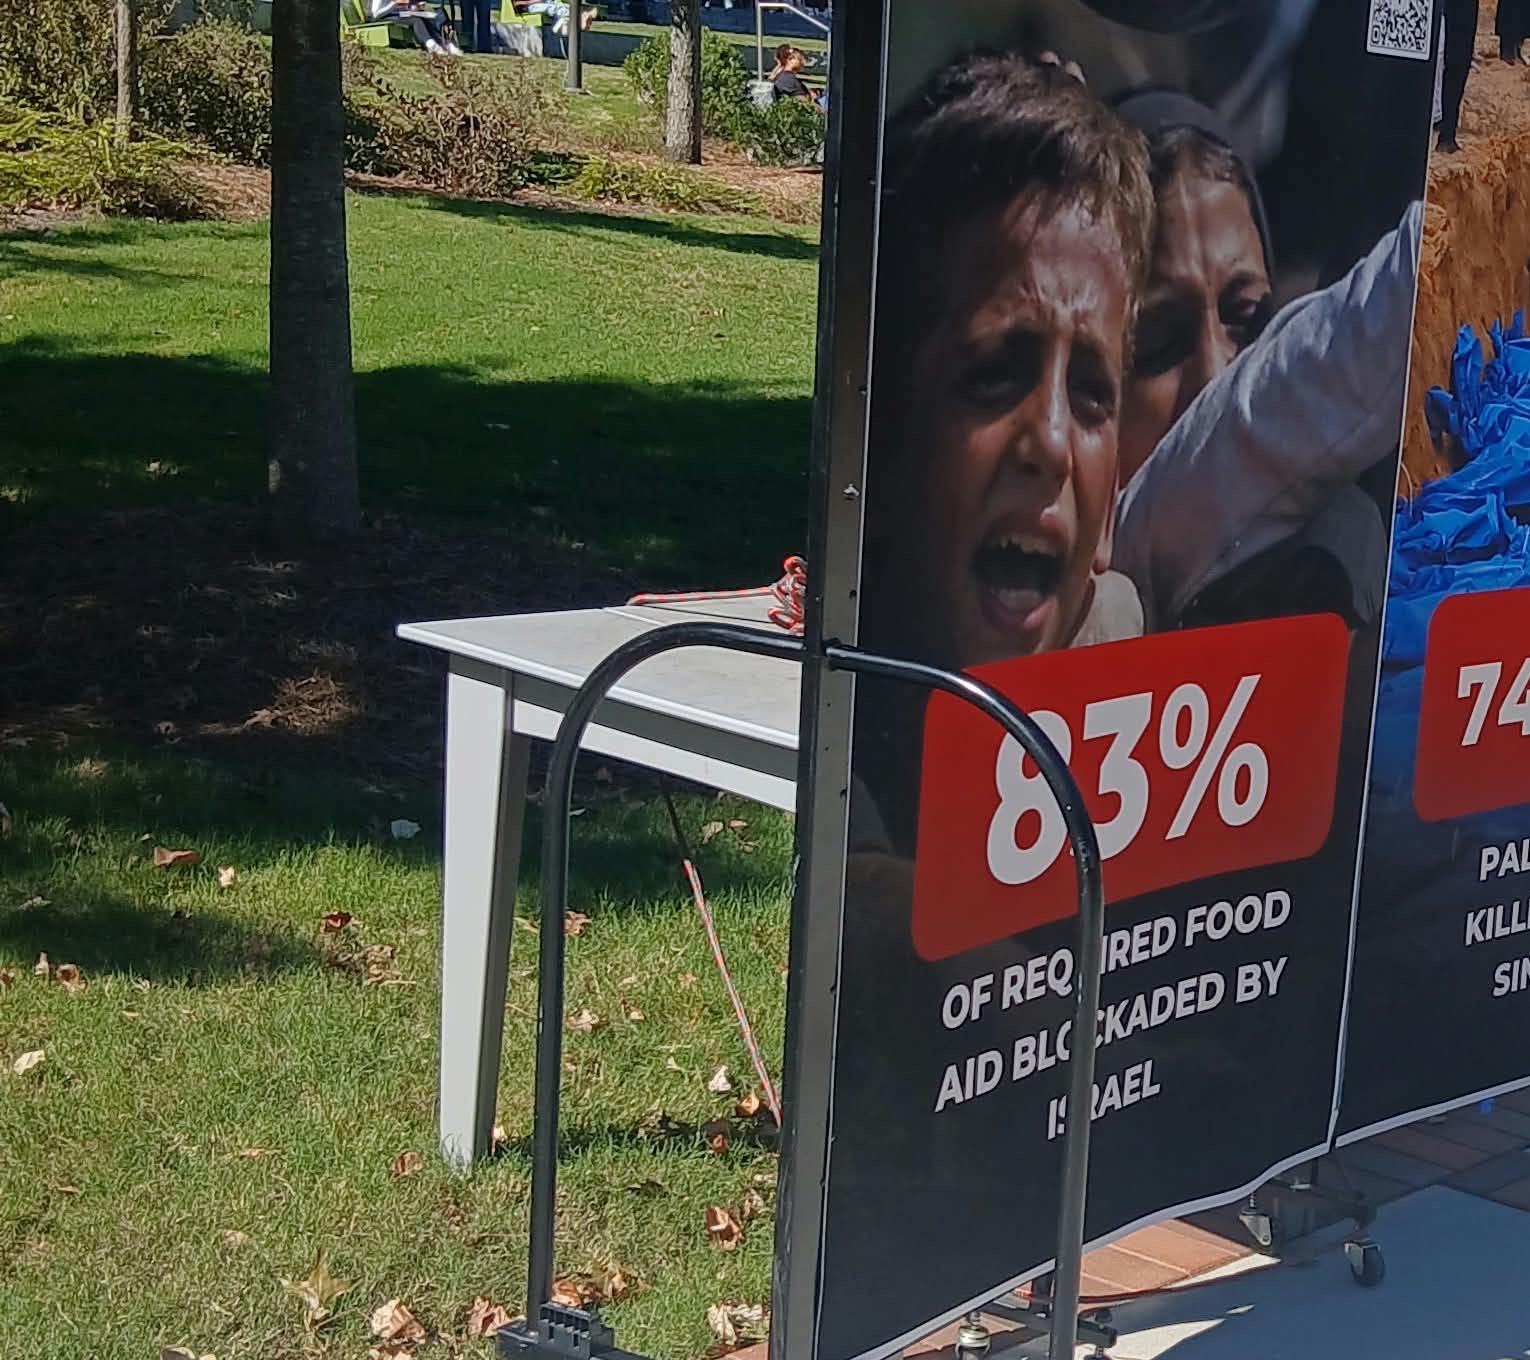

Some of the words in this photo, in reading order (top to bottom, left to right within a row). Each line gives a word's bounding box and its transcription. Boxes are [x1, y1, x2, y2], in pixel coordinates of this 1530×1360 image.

[986, 674, 1269, 886] 83%
[934, 1049, 1003, 1112] AID
[1235, 957, 1288, 1003] BY
[941, 973, 995, 1029] OF
[1002, 916, 1177, 1011] REQIRED
[1184, 890, 1292, 946] FOOD
